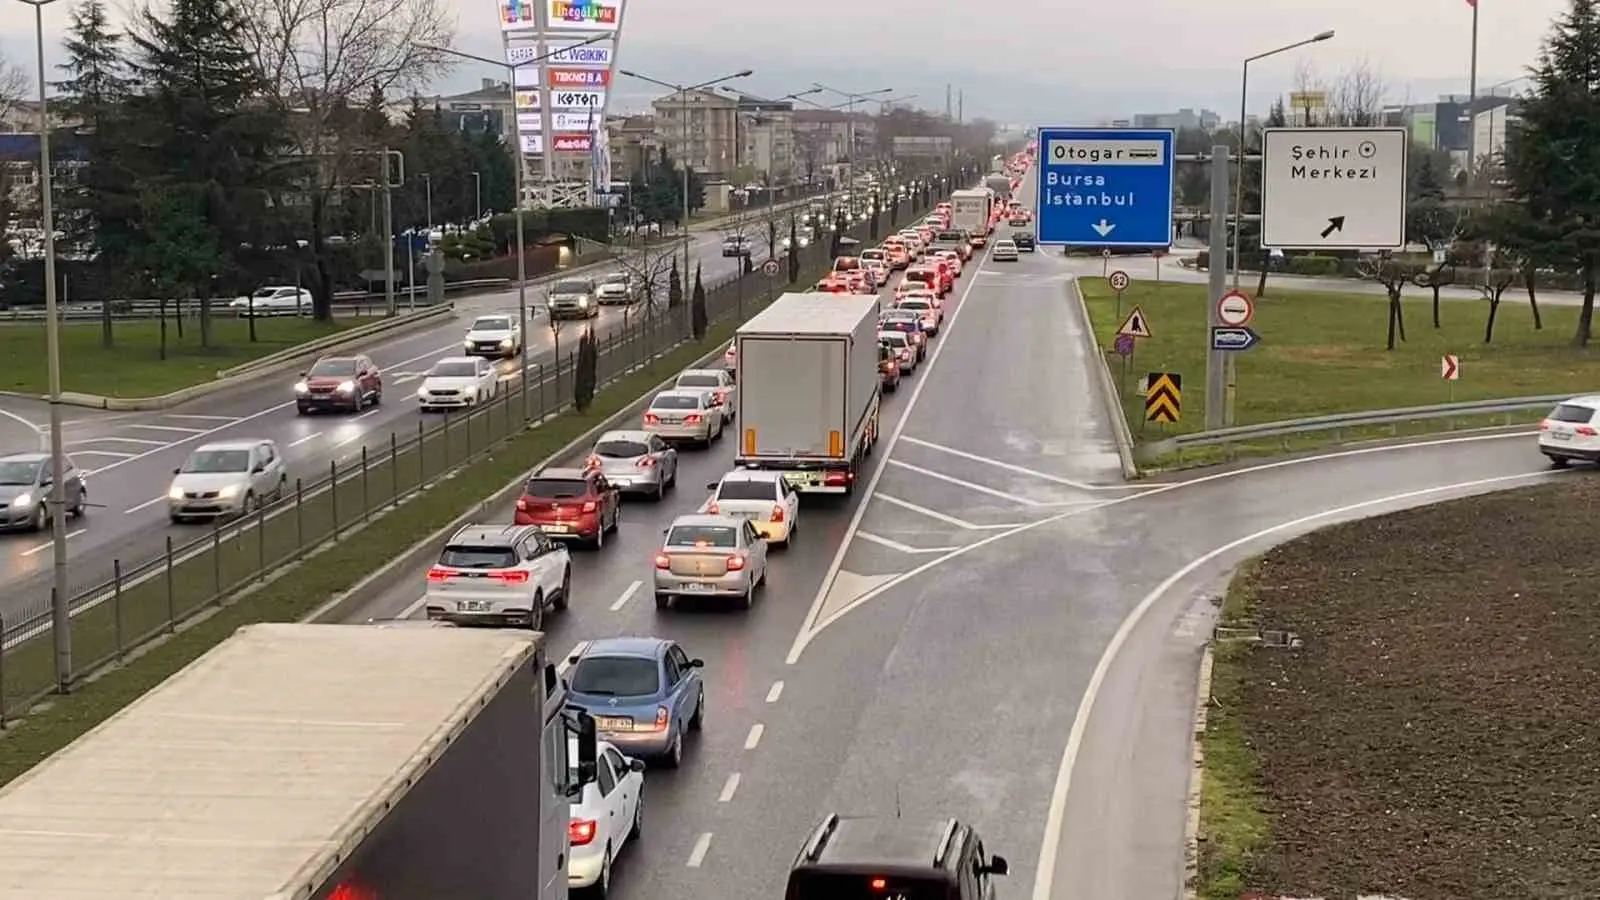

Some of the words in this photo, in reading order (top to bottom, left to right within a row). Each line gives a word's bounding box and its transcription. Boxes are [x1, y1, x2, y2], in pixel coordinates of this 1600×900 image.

[1054, 145, 1124, 162] Otogar
[1291, 145, 1350, 161] Şehir
[1046, 171, 1105, 187] Bursa
[1291, 165, 1377, 179] Merkezi
[1046, 188, 1134, 206] İstanbul
